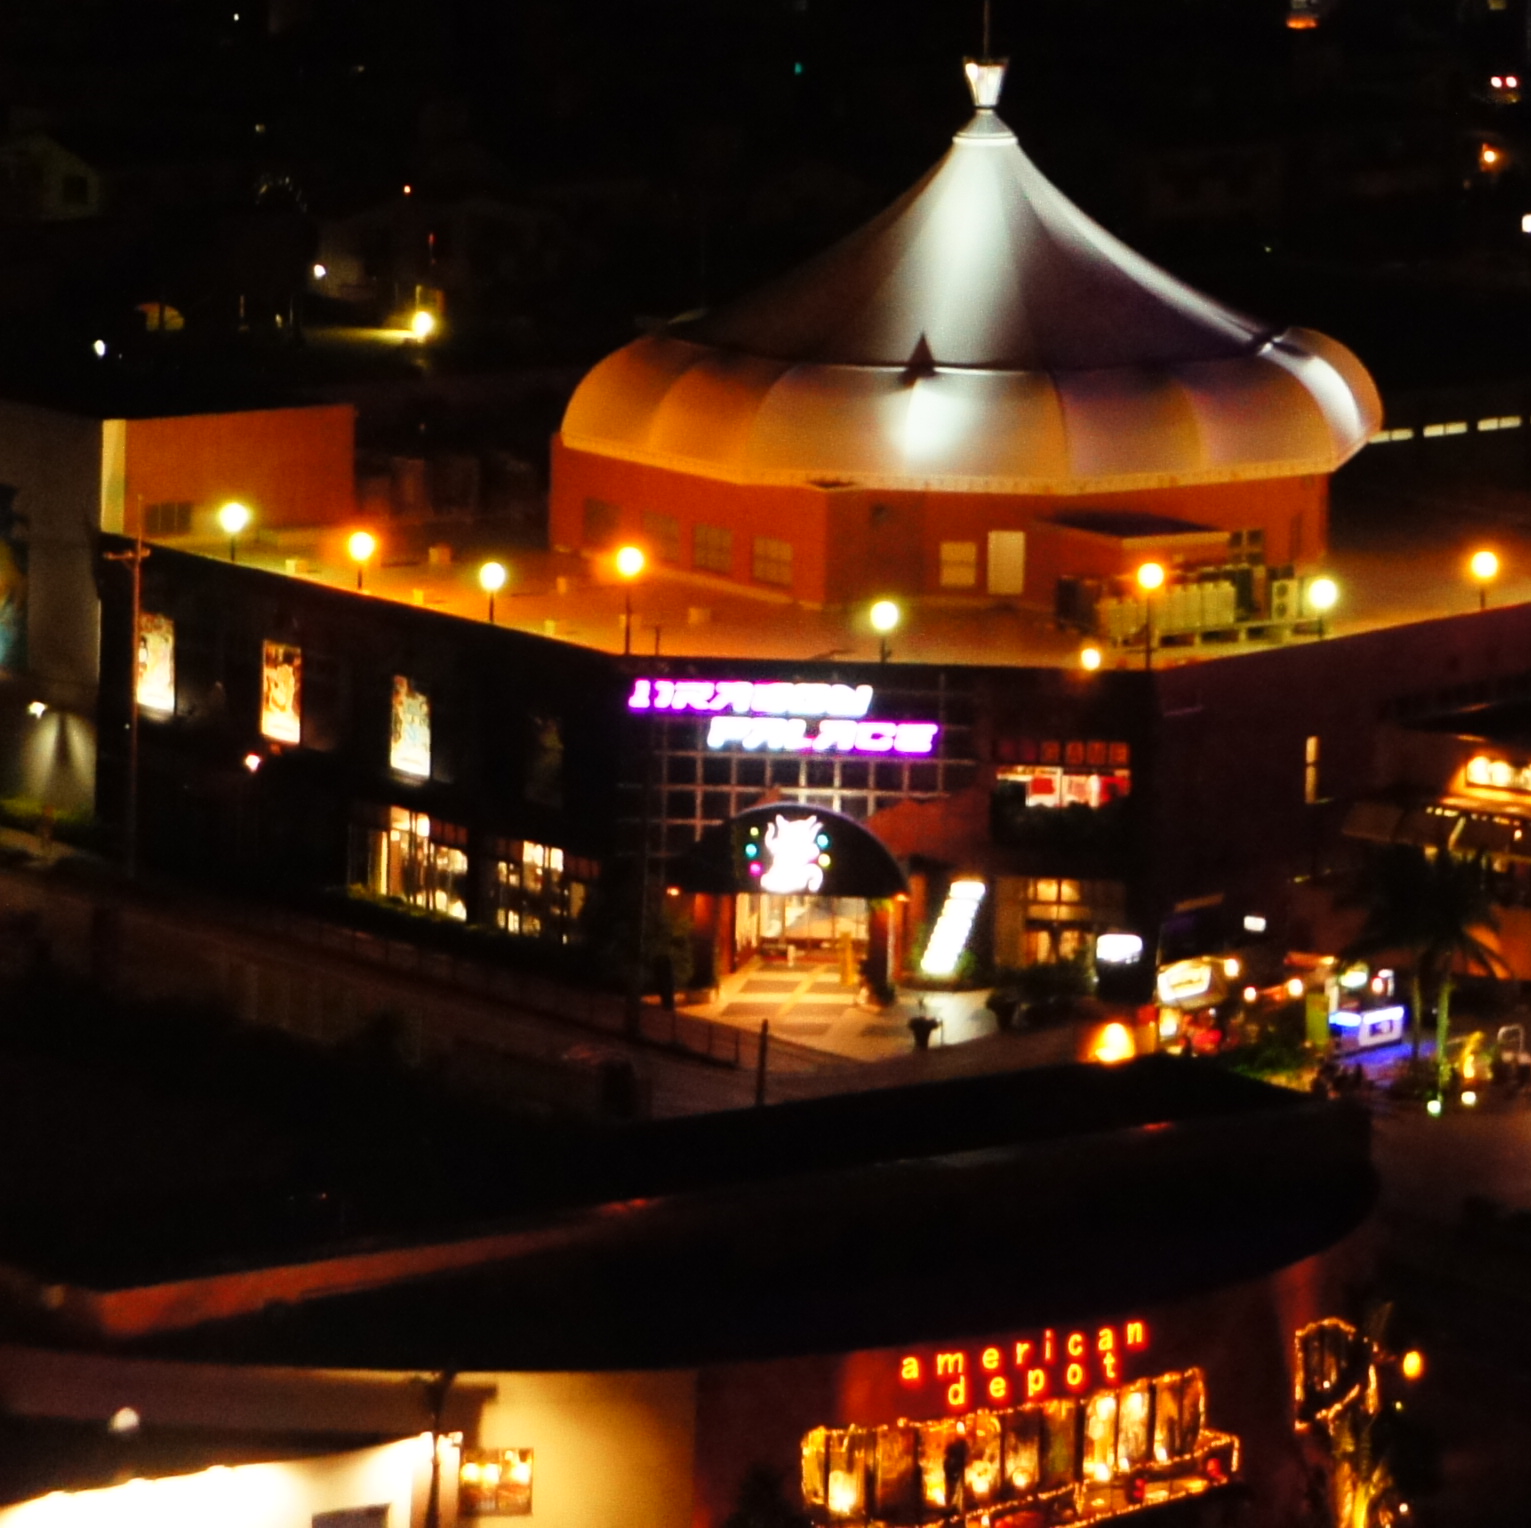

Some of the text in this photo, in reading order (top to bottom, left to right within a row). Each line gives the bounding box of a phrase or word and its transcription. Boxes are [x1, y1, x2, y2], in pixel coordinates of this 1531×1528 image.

[706, 716, 939, 753] PALACE
[901, 1322, 1144, 1380] american
[948, 1352, 1116, 1406] depot
